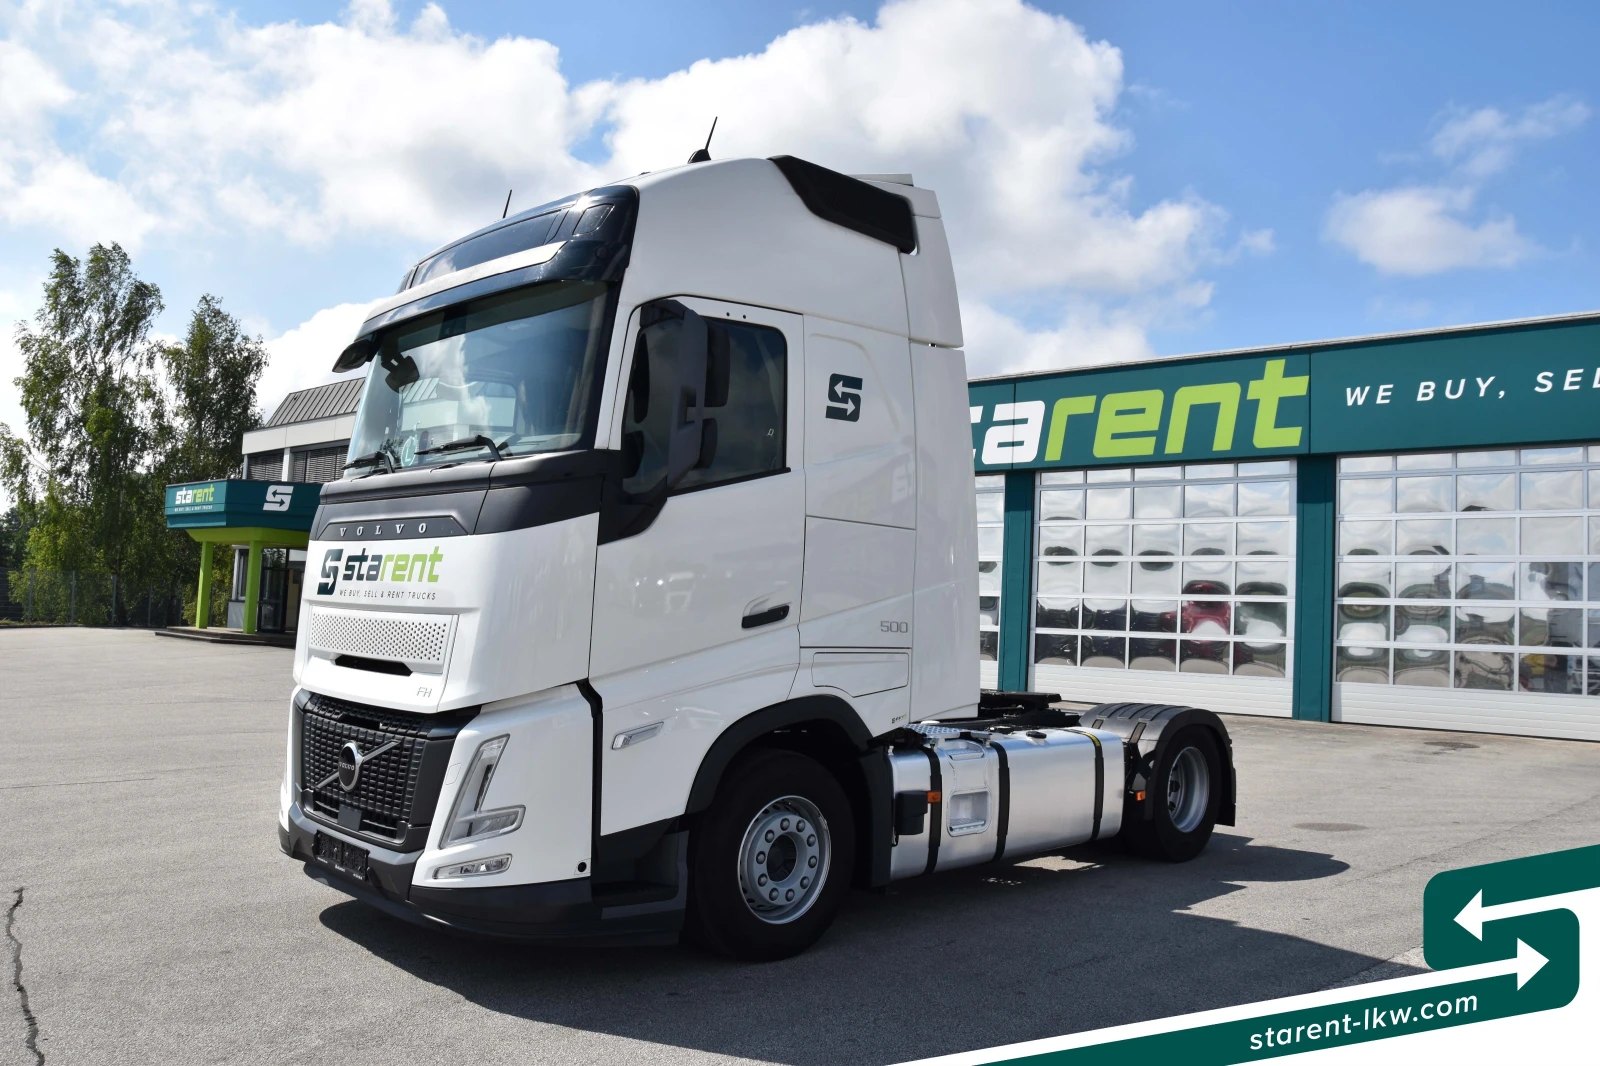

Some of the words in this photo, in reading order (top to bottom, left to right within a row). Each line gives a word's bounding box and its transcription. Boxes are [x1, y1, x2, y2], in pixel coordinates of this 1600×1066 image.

[1346, 384, 1395, 407] WE
[1417, 376, 1505, 402] BUY,
[175, 484, 214, 505] starent
[339, 523, 428, 537] VOLVO
[342, 546, 444, 583] starent
[339, 589, 347, 597] WE
[348, 589, 361, 598] BUY,
[364, 590, 378, 598] SELL
[387, 591, 404, 599] RENT
[408, 591, 436, 600] TRUCKS
[880, 620, 908, 634] 500
[416, 686, 433, 698] FH
[339, 761, 355, 771] VOLVO
